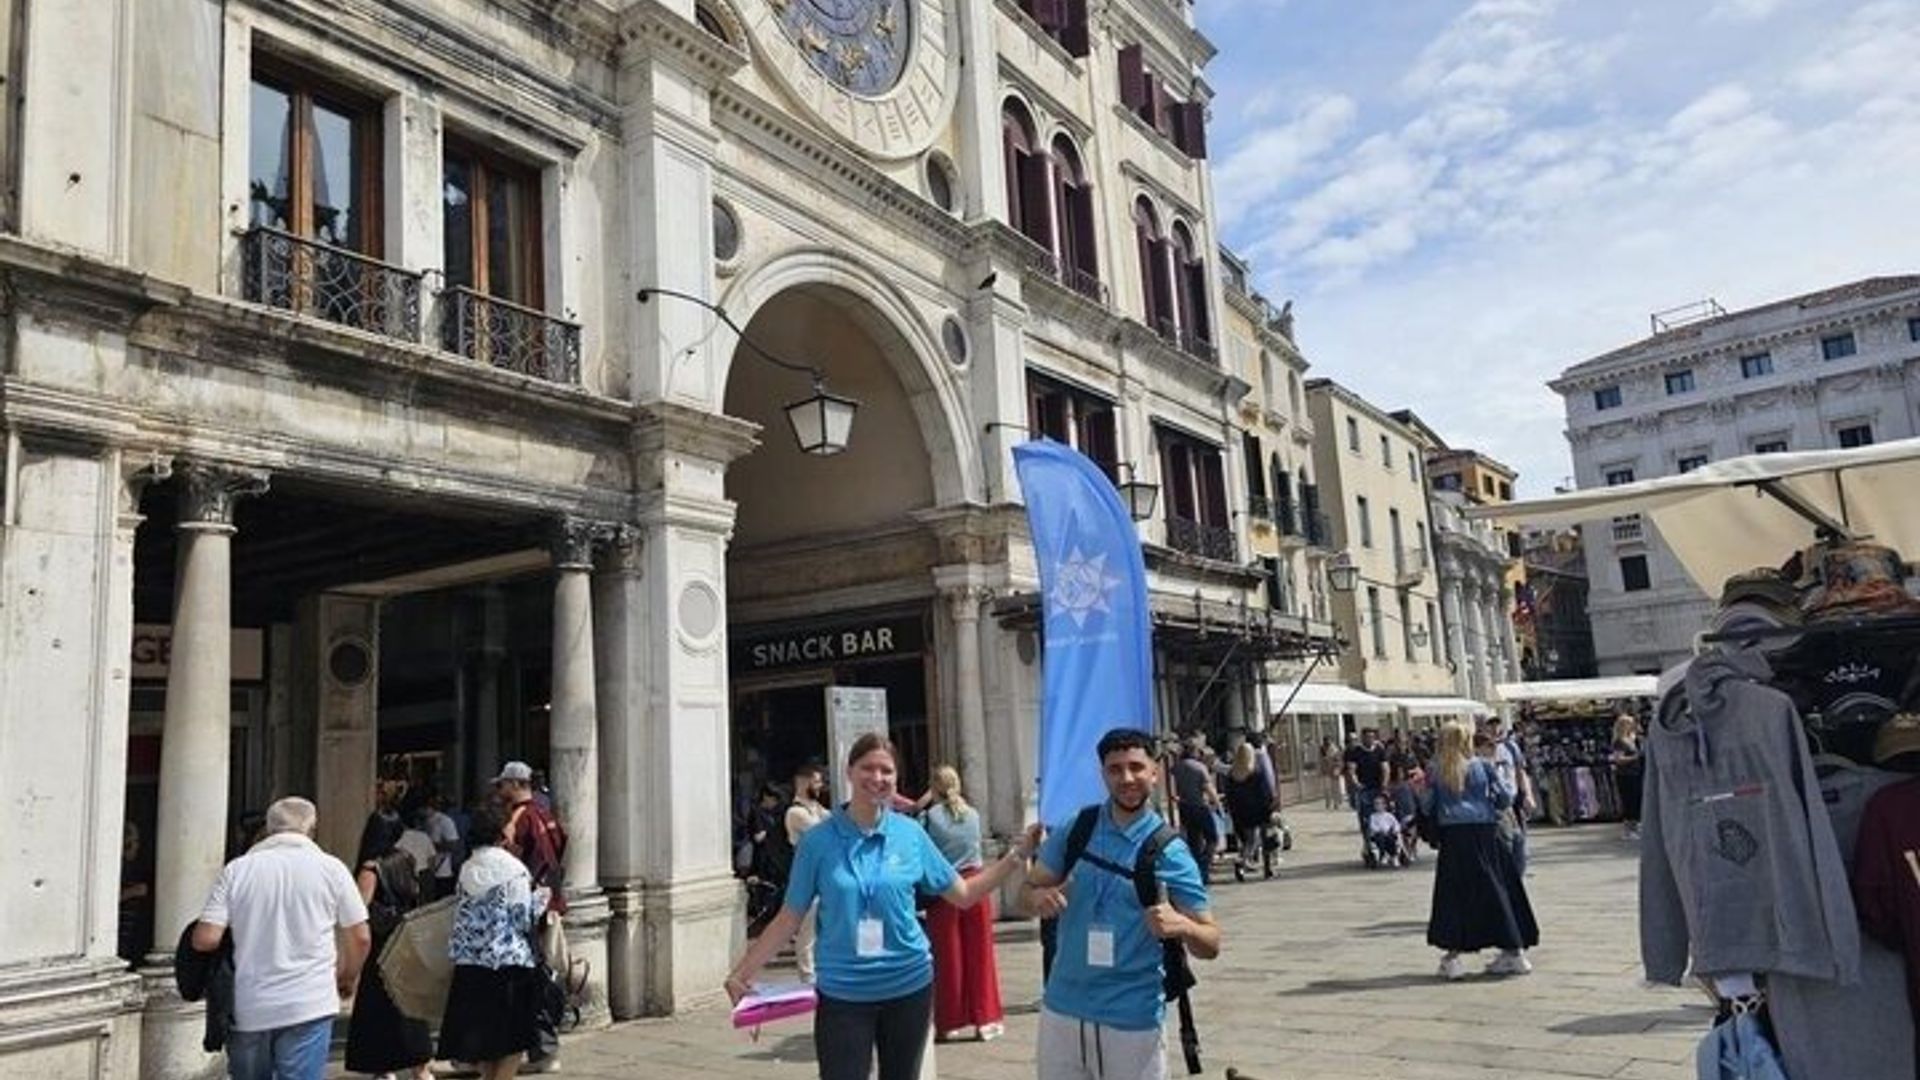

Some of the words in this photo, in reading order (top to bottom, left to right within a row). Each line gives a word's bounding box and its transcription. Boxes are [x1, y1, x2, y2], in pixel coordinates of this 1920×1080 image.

[885, 115, 902, 140] IIII
[753, 634, 834, 667] SNACK
[842, 627, 895, 655] BAR
